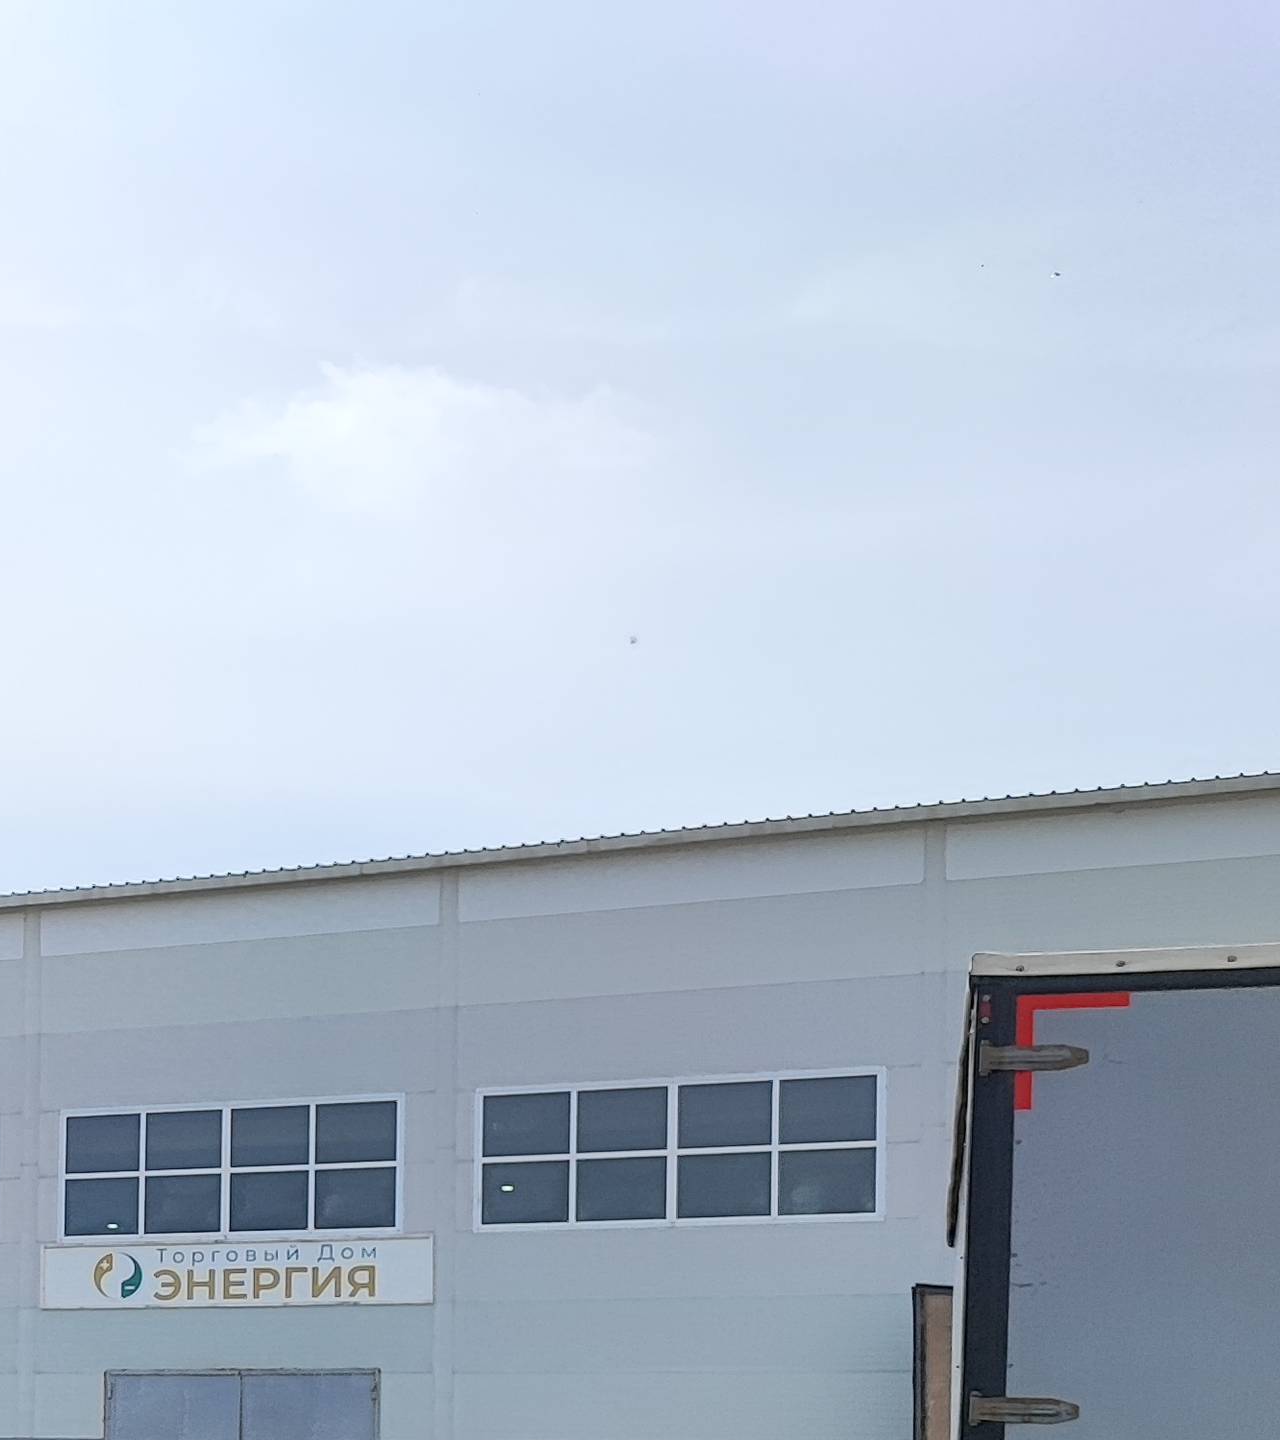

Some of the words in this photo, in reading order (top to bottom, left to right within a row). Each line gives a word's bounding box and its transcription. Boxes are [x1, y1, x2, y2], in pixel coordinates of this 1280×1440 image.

[156, 1244, 300, 1266] Торговый
[317, 1243, 378, 1262] Дом
[152, 1264, 377, 1300] ЭНЕРГИЯ
